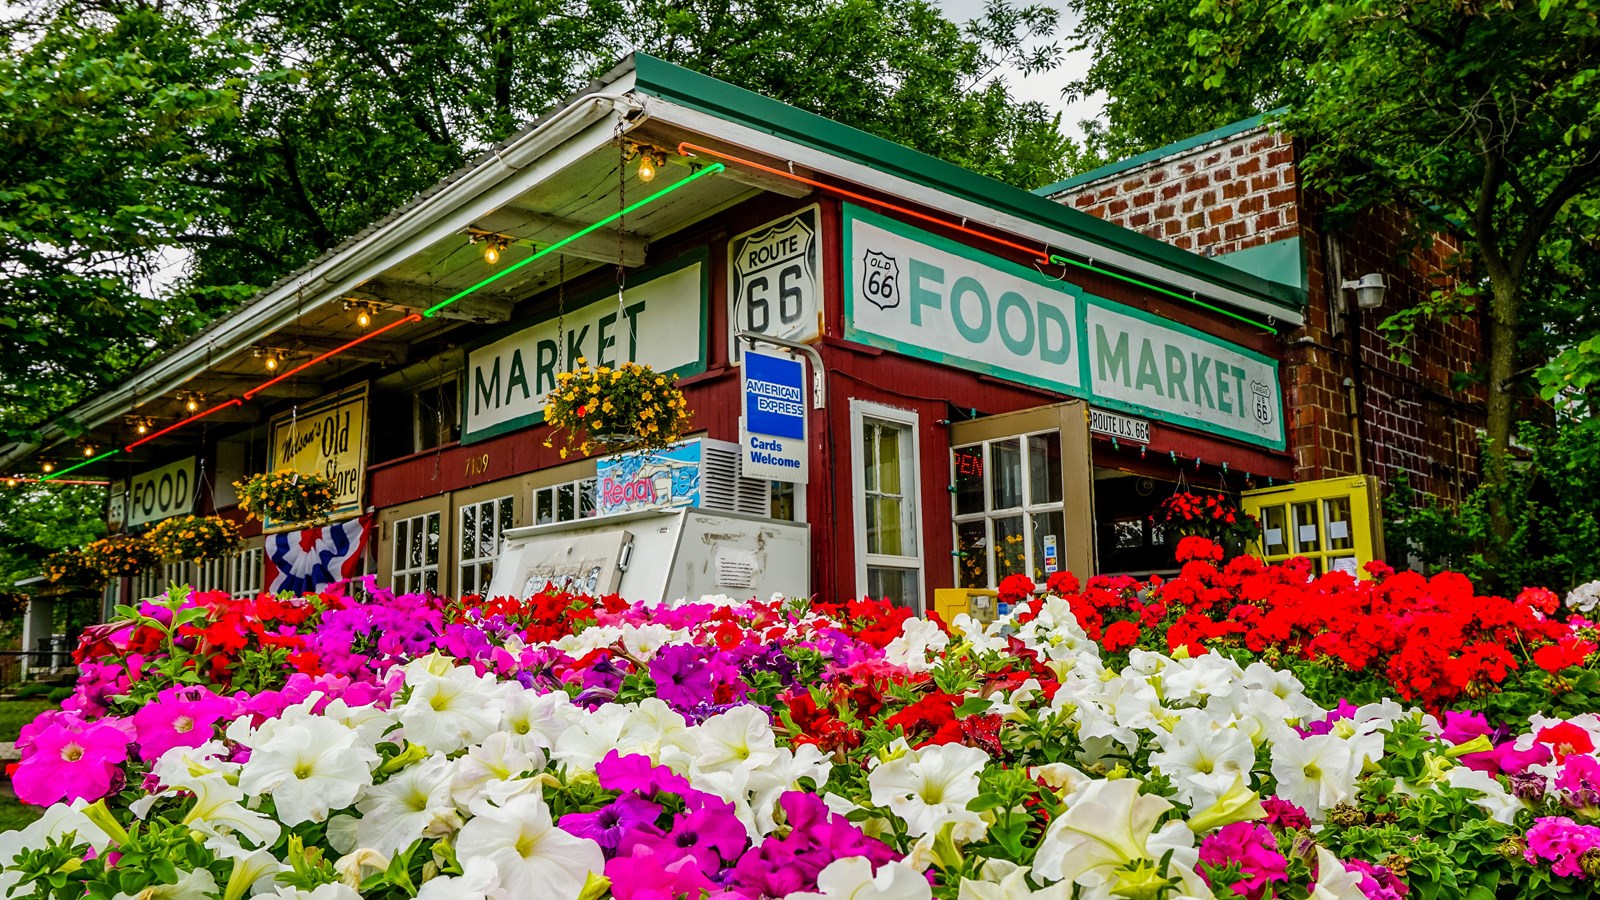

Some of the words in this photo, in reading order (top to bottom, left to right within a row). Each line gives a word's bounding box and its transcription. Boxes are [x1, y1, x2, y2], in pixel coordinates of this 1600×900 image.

[748, 234, 798, 269] ROUTE
[869, 257, 892, 271] OLD
[868, 270, 895, 299] 66
[746, 264, 803, 334] 66
[908, 257, 1071, 365] FOOD
[475, 300, 646, 416] MARKET
[1095, 323, 1246, 419] MARKET
[746, 378, 800, 401] AMERICAN
[758, 396, 803, 417] EXPRESS
[1256, 402, 1268, 421] 66
[281, 421, 321, 464] Nelson's
[321, 410, 350, 458] Old
[1092, 412, 1117, 433] ROUTE
[1118, 418, 1134, 437] U.S.
[1135, 422, 1145, 439] 66
[750, 436, 783, 452] Cards
[465, 453, 489, 478] 7109
[750, 451, 801, 469] Welcome
[954, 452, 984, 477] PEN
[132, 468, 188, 520] FOOD
